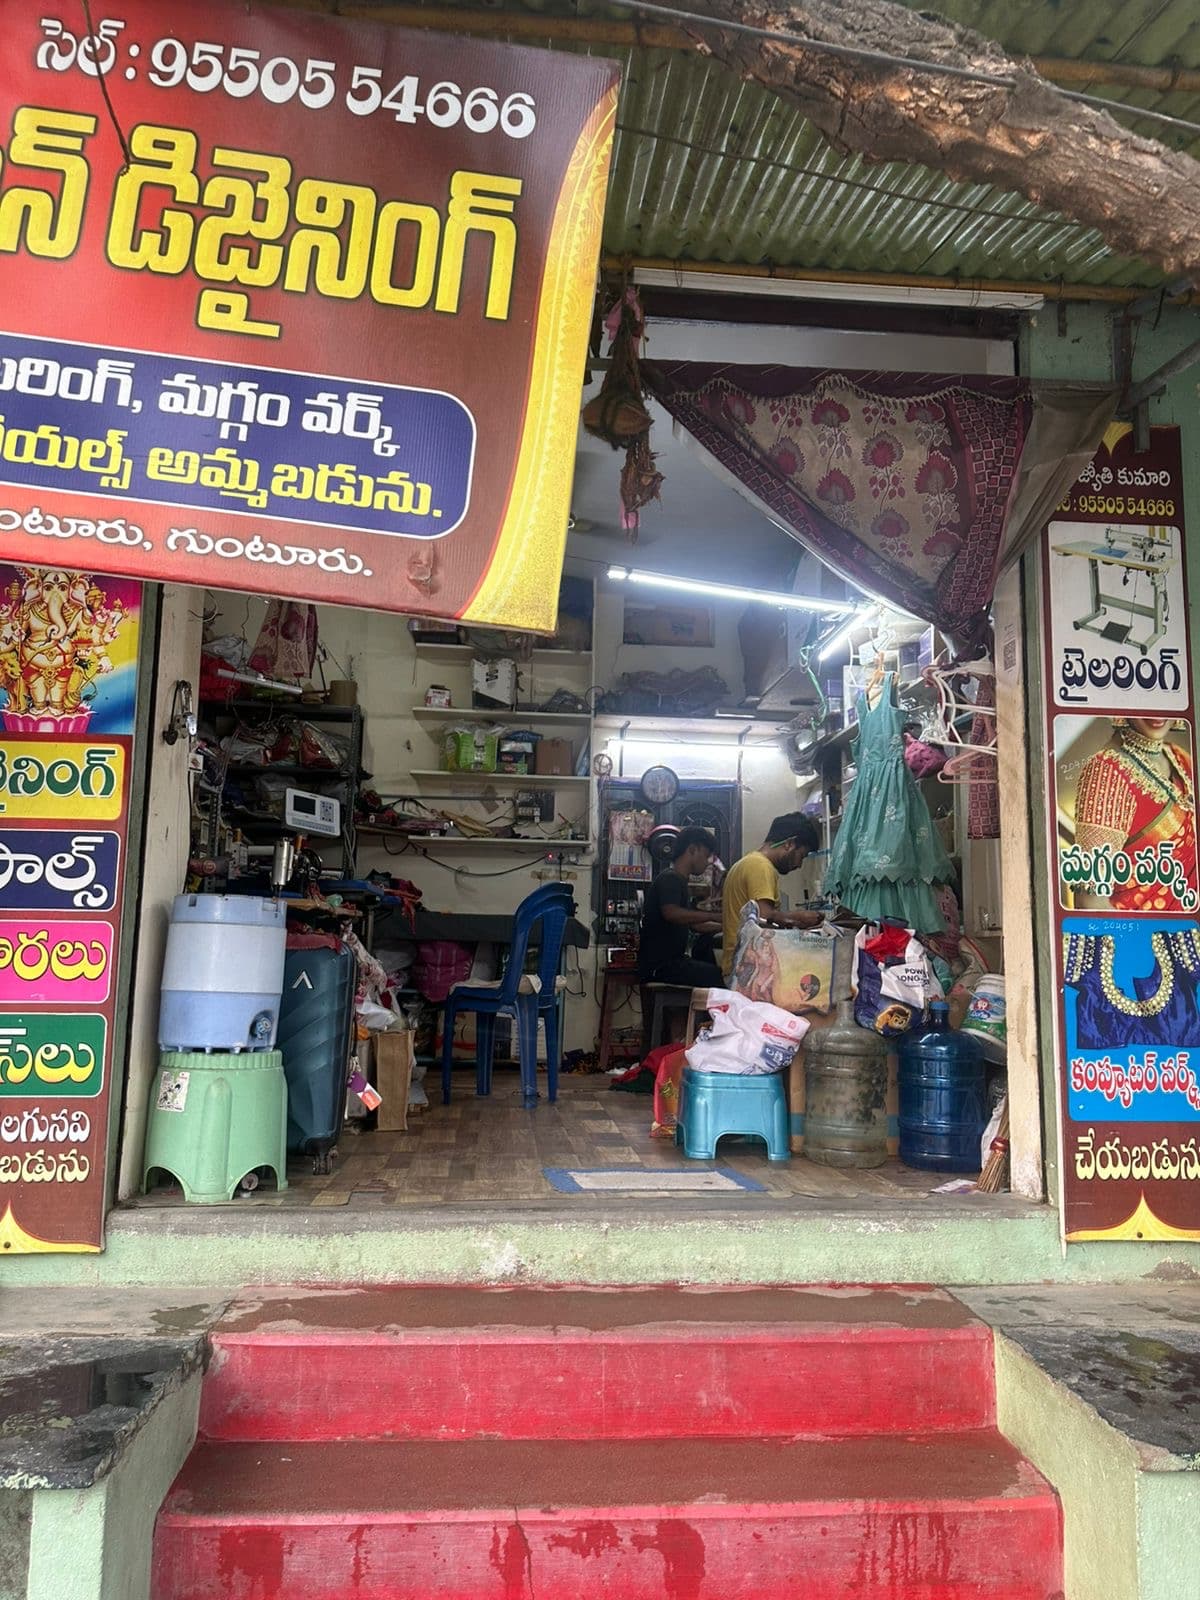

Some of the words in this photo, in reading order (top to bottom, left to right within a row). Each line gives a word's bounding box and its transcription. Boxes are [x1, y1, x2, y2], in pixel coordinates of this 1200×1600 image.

[148, 38, 336, 109] 95505
[346, 66, 536, 139] 54666
[0, 105, 97, 260] న్
[106, 123, 524, 339] డిజైనింగ్
[158, 372, 291, 442] మగ్గం
[0, 415, 134, 490] యల్స్
[1118, 467, 1171, 487] కుమారి
[1079, 496, 1125, 514] 95505
[1127, 498, 1175, 517] 54666
[1059, 648, 1182, 702] టైలరింగ్
[0, 748, 118, 813] నింగ్
[1062, 844, 1132, 896] మగ్గం
[1075, 1127, 1200, 1180] చేయబడున
